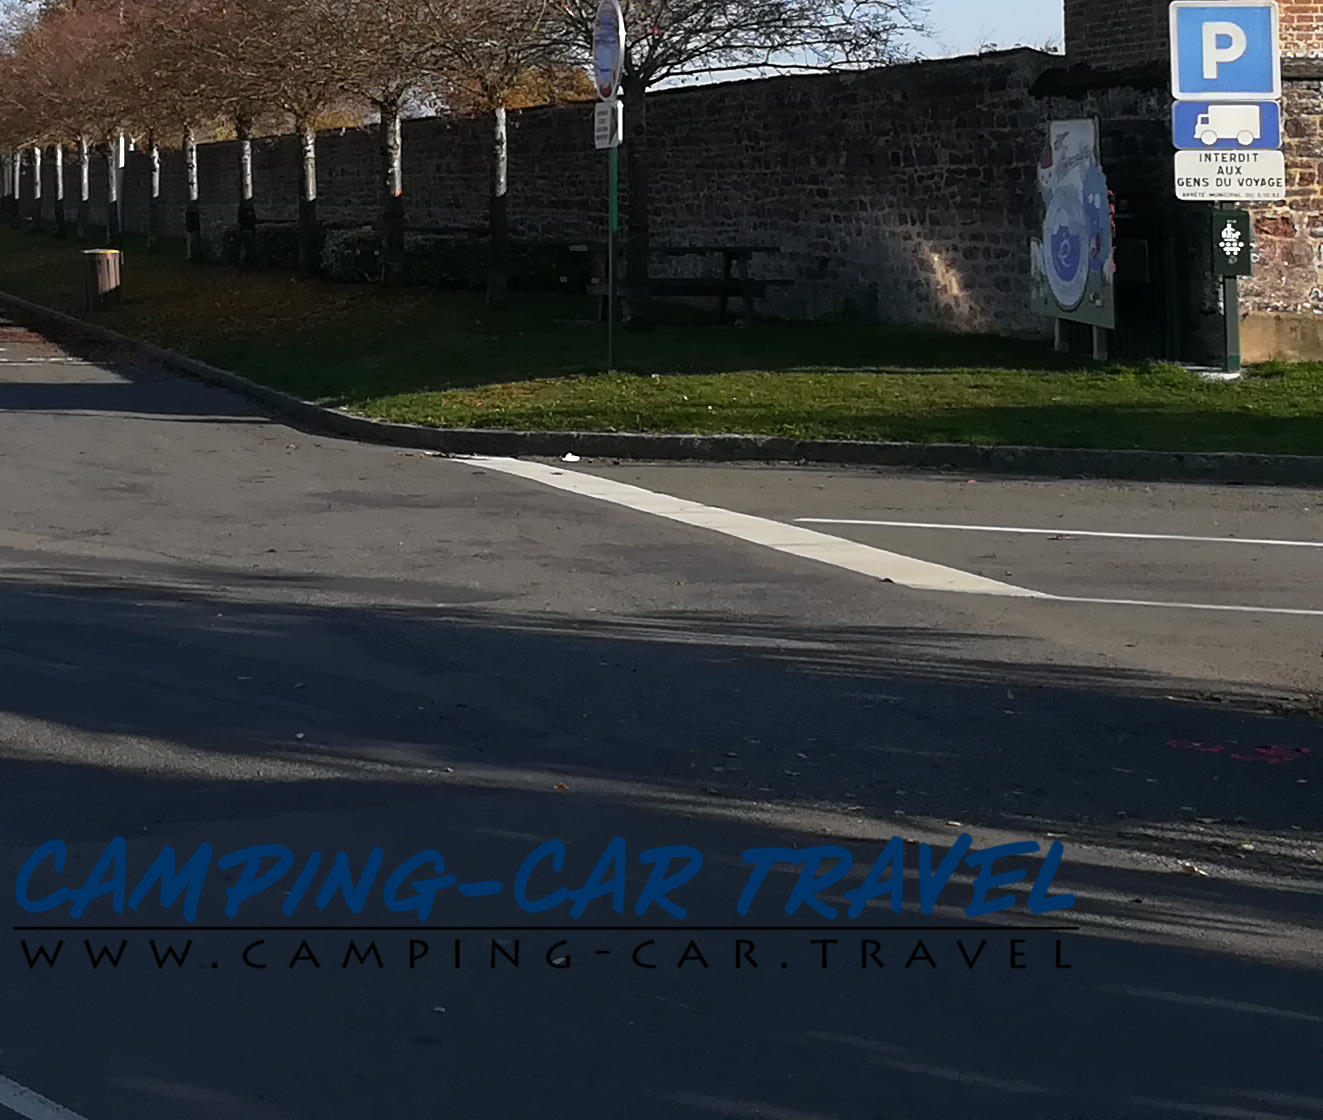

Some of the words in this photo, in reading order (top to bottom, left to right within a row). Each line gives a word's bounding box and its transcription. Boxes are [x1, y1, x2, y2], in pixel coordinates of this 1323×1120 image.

[1202, 22, 1247, 79] P
[1198, 152, 1259, 163] INTERDIT
[1217, 165, 1242, 175] AUX
[1177, 177, 1210, 187] GENS
[1216, 177, 1232, 187] DU
[1237, 177, 1283, 188] VOYAGE
